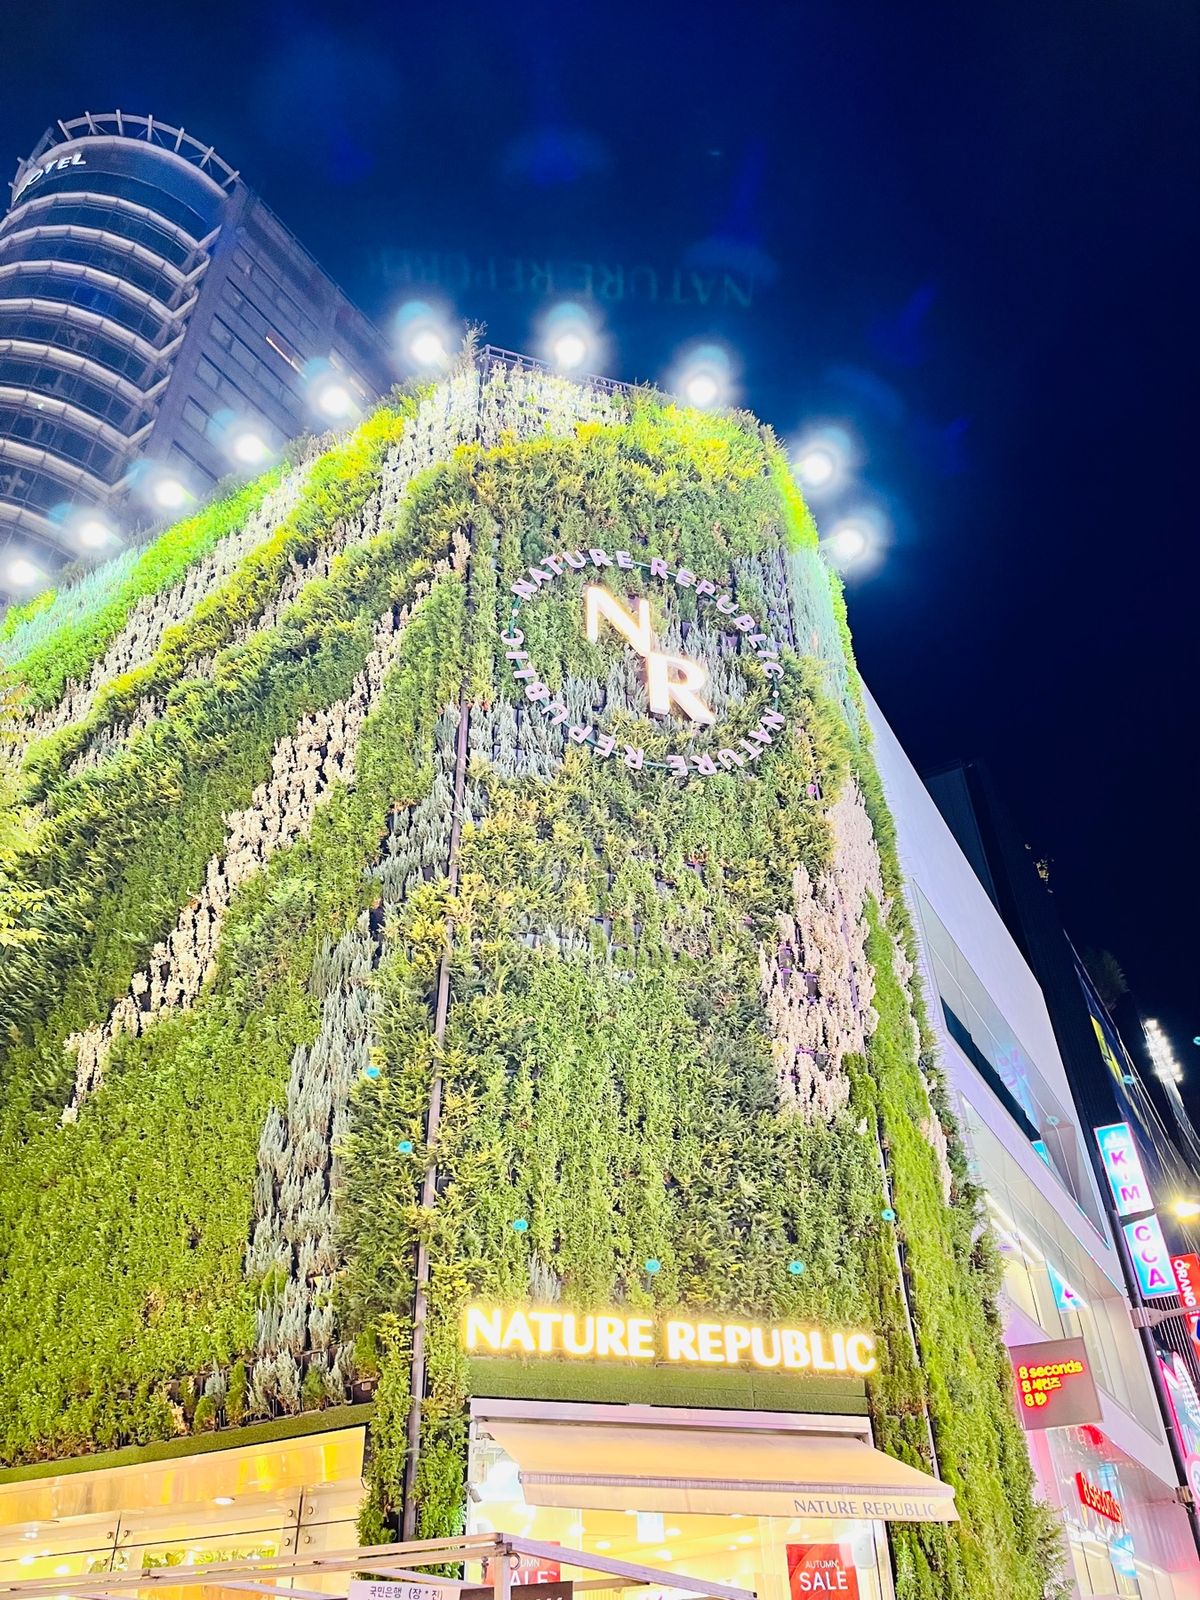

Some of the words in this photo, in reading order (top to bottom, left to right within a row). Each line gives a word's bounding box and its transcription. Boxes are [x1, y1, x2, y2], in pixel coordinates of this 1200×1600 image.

[14, 153, 87, 202] OTEL
[510, 549, 634, 602] NATURE
[650, 557, 784, 680] REPUBLIC
[500, 627, 644, 770] REPUBLIC
[666, 706, 785, 776] NATURE
[465, 1308, 655, 1358] NATURE
[666, 1320, 878, 1374] REPUBLIC
[794, 1500, 859, 1514] NATURE
[863, 1502, 938, 1517] REPUBLIC
[800, 1571, 848, 1591] SALE
[805, 1560, 838, 1569] AUTUMN
[370, 1586, 402, 1599] 국민은행
